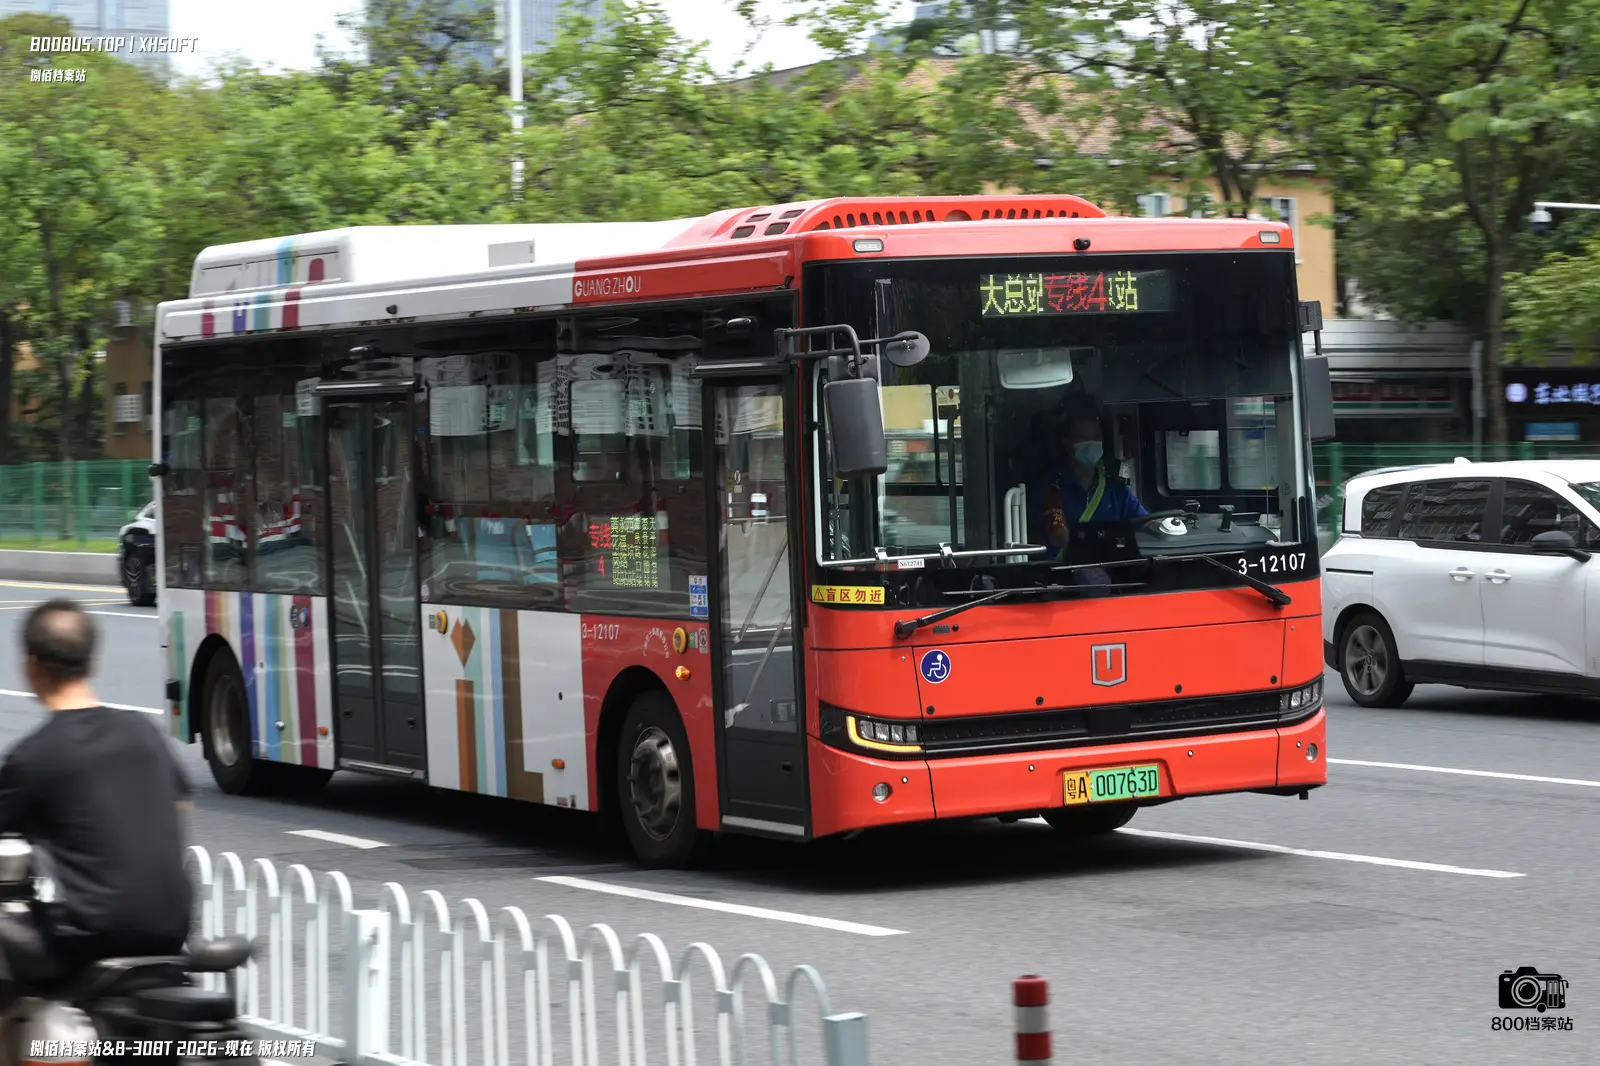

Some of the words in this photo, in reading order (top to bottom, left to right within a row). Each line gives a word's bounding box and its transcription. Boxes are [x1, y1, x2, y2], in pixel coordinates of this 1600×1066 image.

[1238, 552, 1306, 575] 3-12107
[825, 588, 883, 603] 盲区勿近
[581, 623, 619, 640] 3-12107
